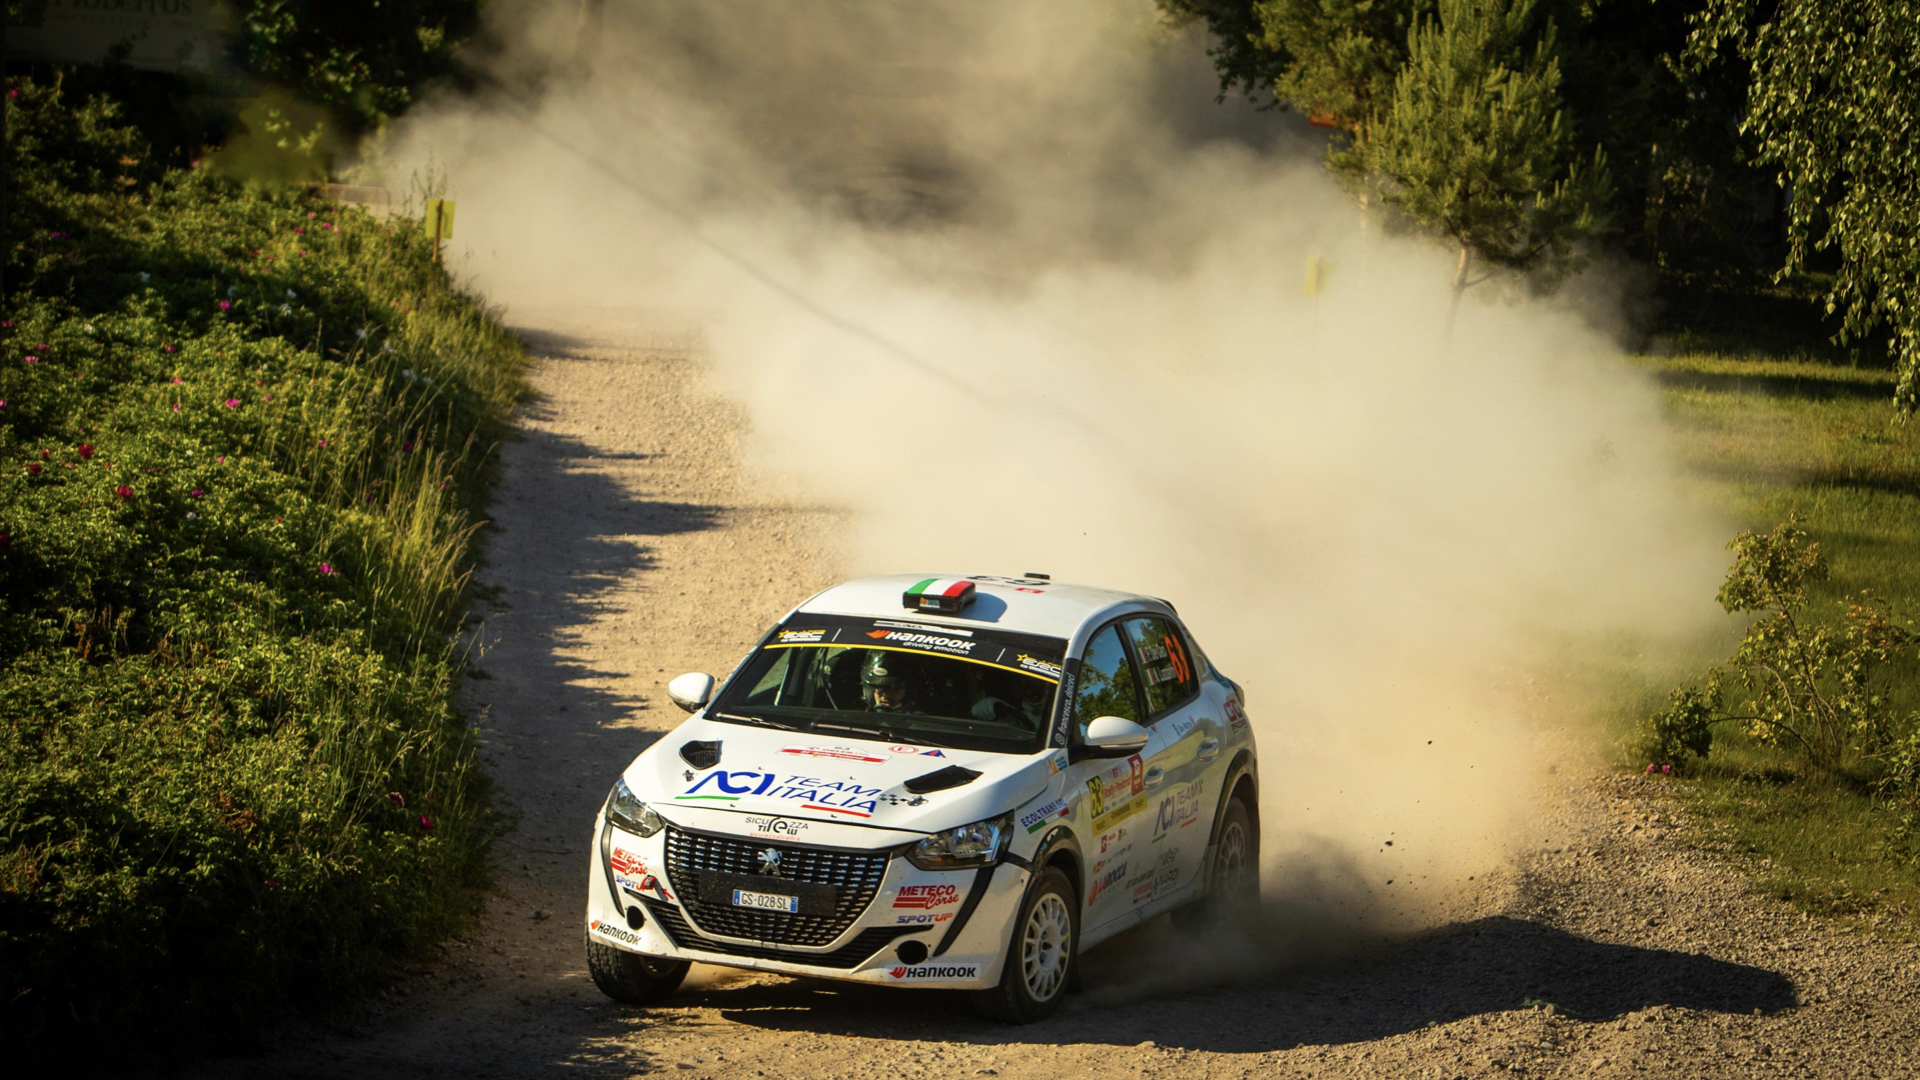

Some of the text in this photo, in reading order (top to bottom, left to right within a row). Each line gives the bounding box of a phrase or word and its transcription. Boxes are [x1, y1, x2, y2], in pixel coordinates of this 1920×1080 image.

[902, 641, 969, 655] driving emotion
[1164, 633, 1190, 684] 63
[783, 775, 883, 797] TEAM
[766, 785, 877, 813] ITALIA
[1089, 777, 1103, 817] 63
[1020, 801, 1057, 828] ECOLTRANS
[613, 846, 648, 865] METECO
[624, 862, 648, 875] Corse
[616, 875, 645, 891] SPOTU
[898, 884, 955, 896] METECO
[924, 893, 959, 910] Corse
[896, 913, 953, 924] SPOTUP
